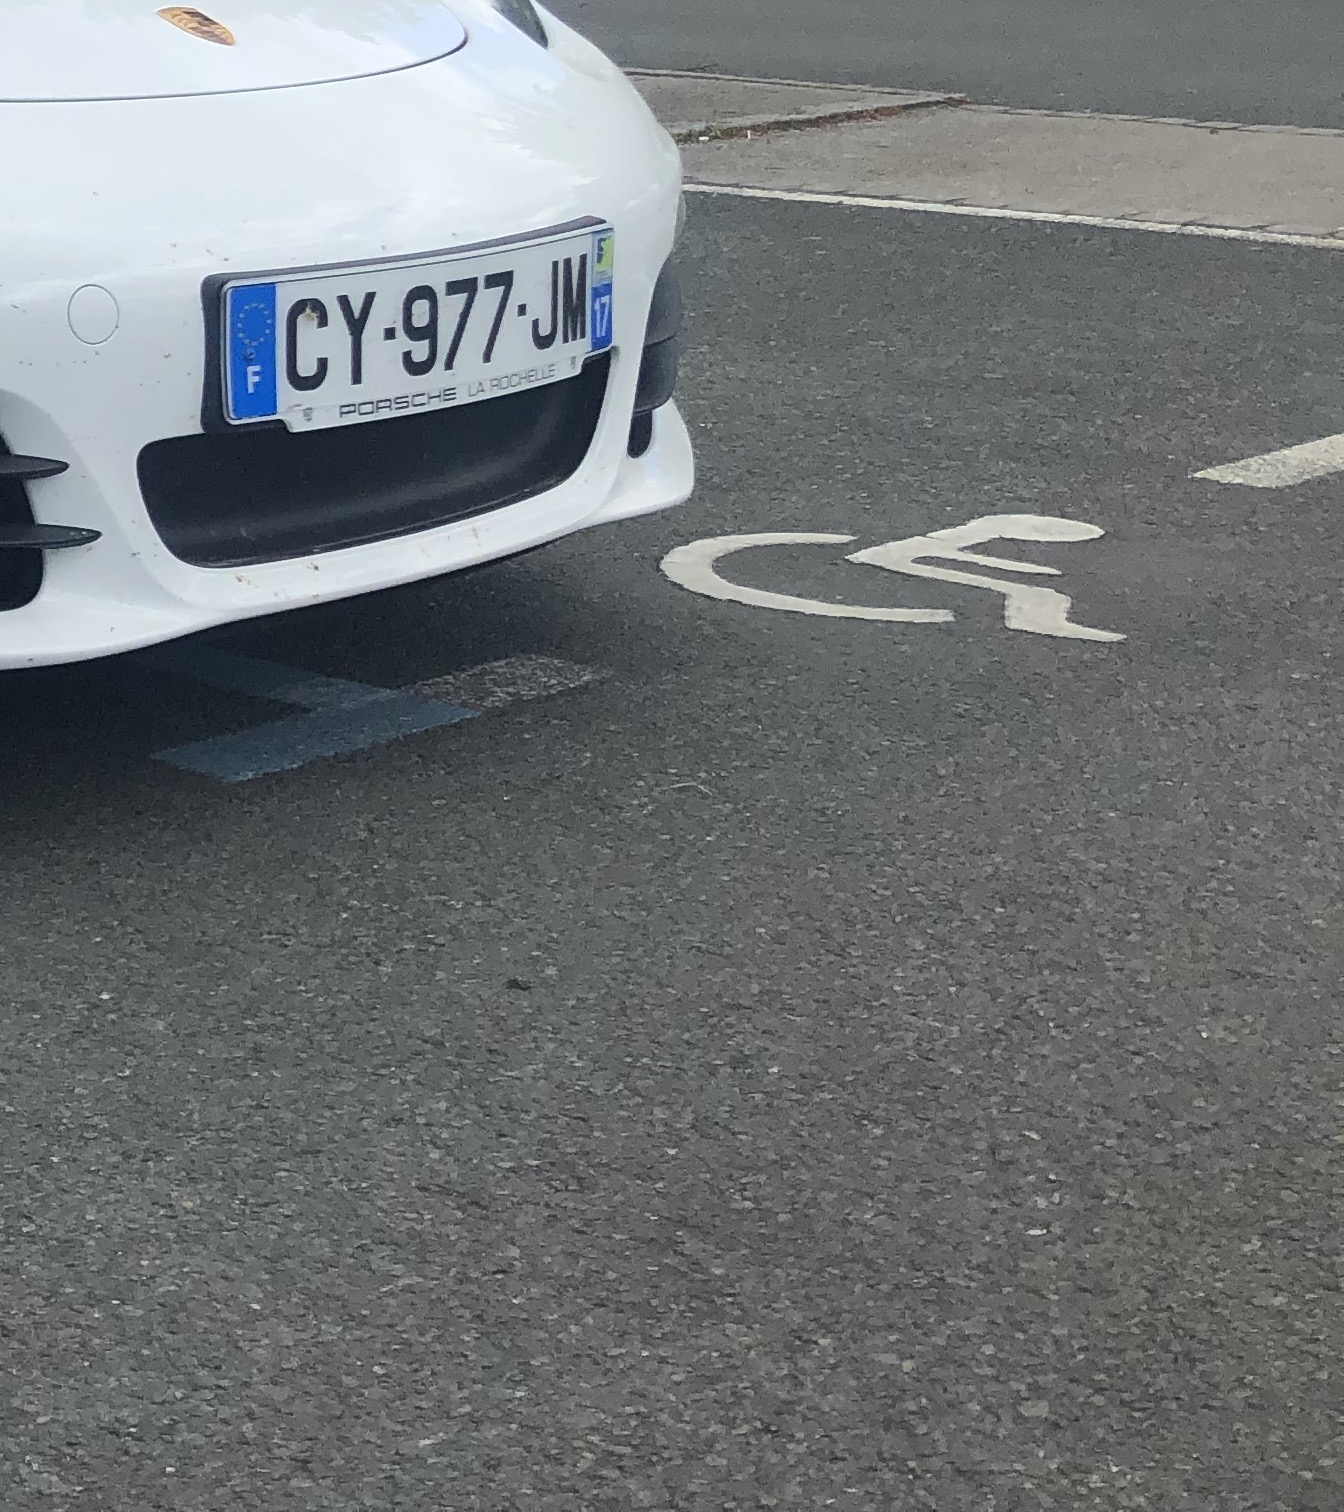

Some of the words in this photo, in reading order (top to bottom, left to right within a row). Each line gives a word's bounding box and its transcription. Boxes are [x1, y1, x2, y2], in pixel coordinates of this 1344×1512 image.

[286, 253, 588, 392] CY-977-JM
[594, 294, 610, 338] 17
[247, 365, 261, 393] F
[339, 388, 457, 418] PORSCHE
[468, 381, 485, 397] LA
[490, 364, 555, 392] ROCHELLE
